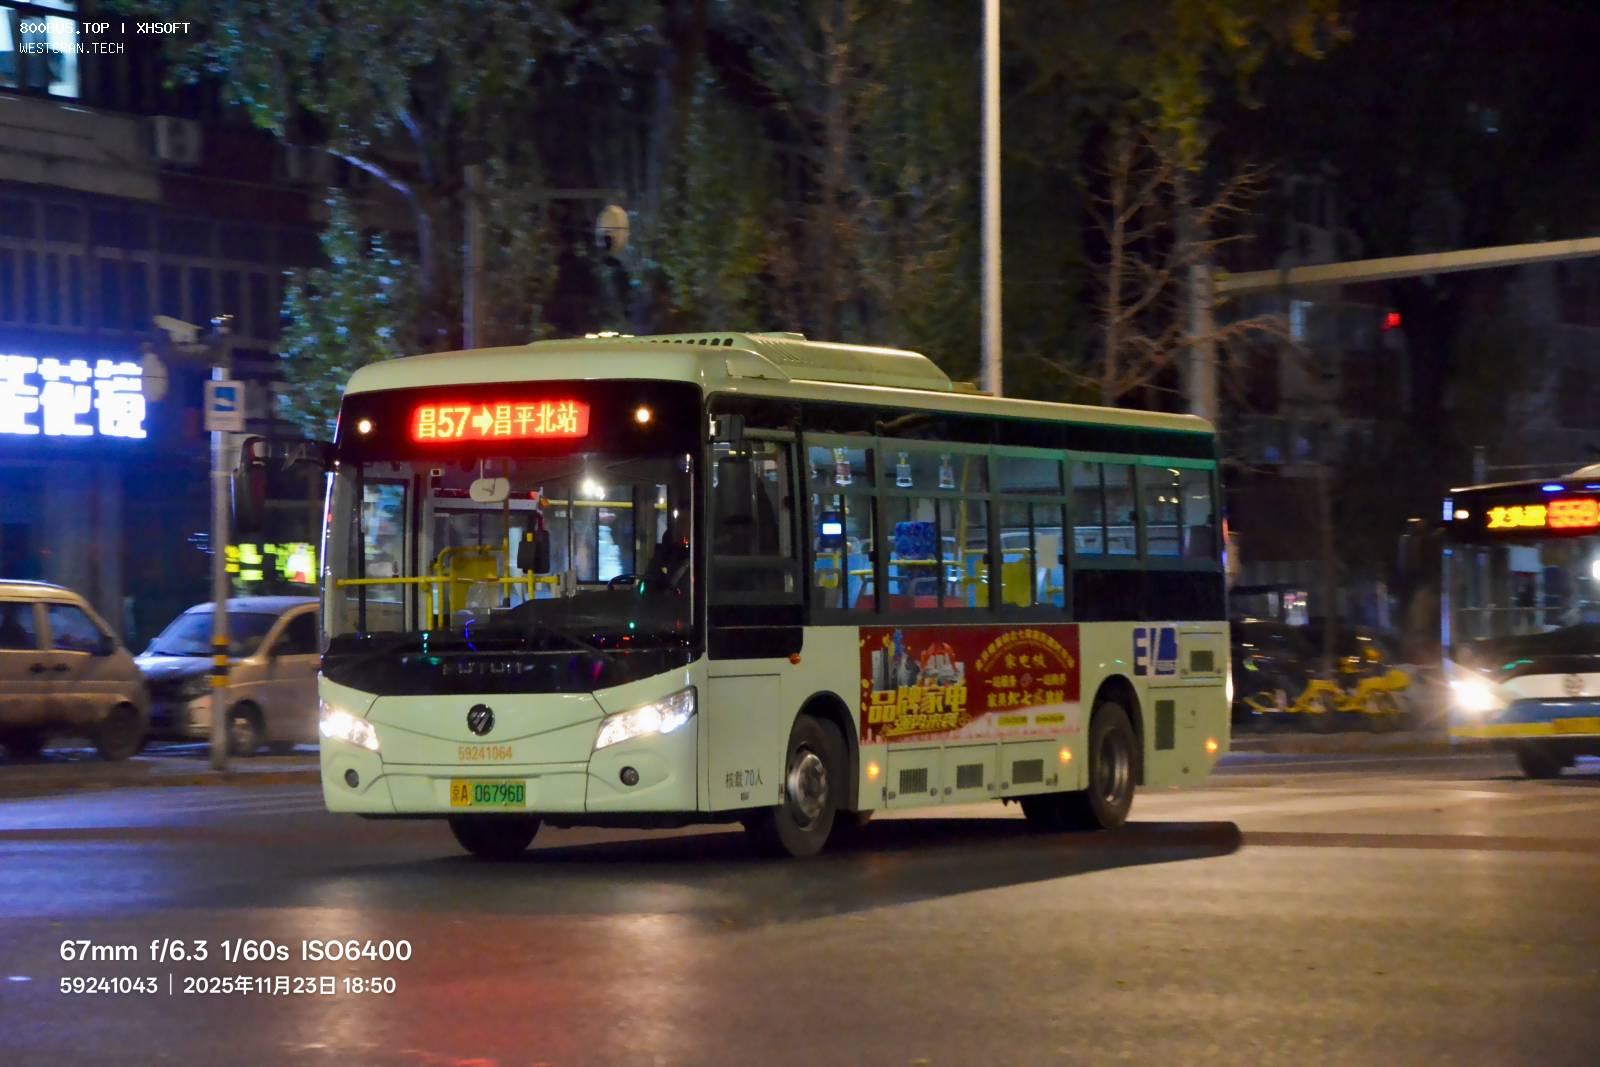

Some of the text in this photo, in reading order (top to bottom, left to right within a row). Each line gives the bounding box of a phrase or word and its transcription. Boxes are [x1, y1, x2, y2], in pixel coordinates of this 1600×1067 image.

[418, 403, 579, 438] 昌57 昌平北站
[457, 745, 513, 761] 59241064
